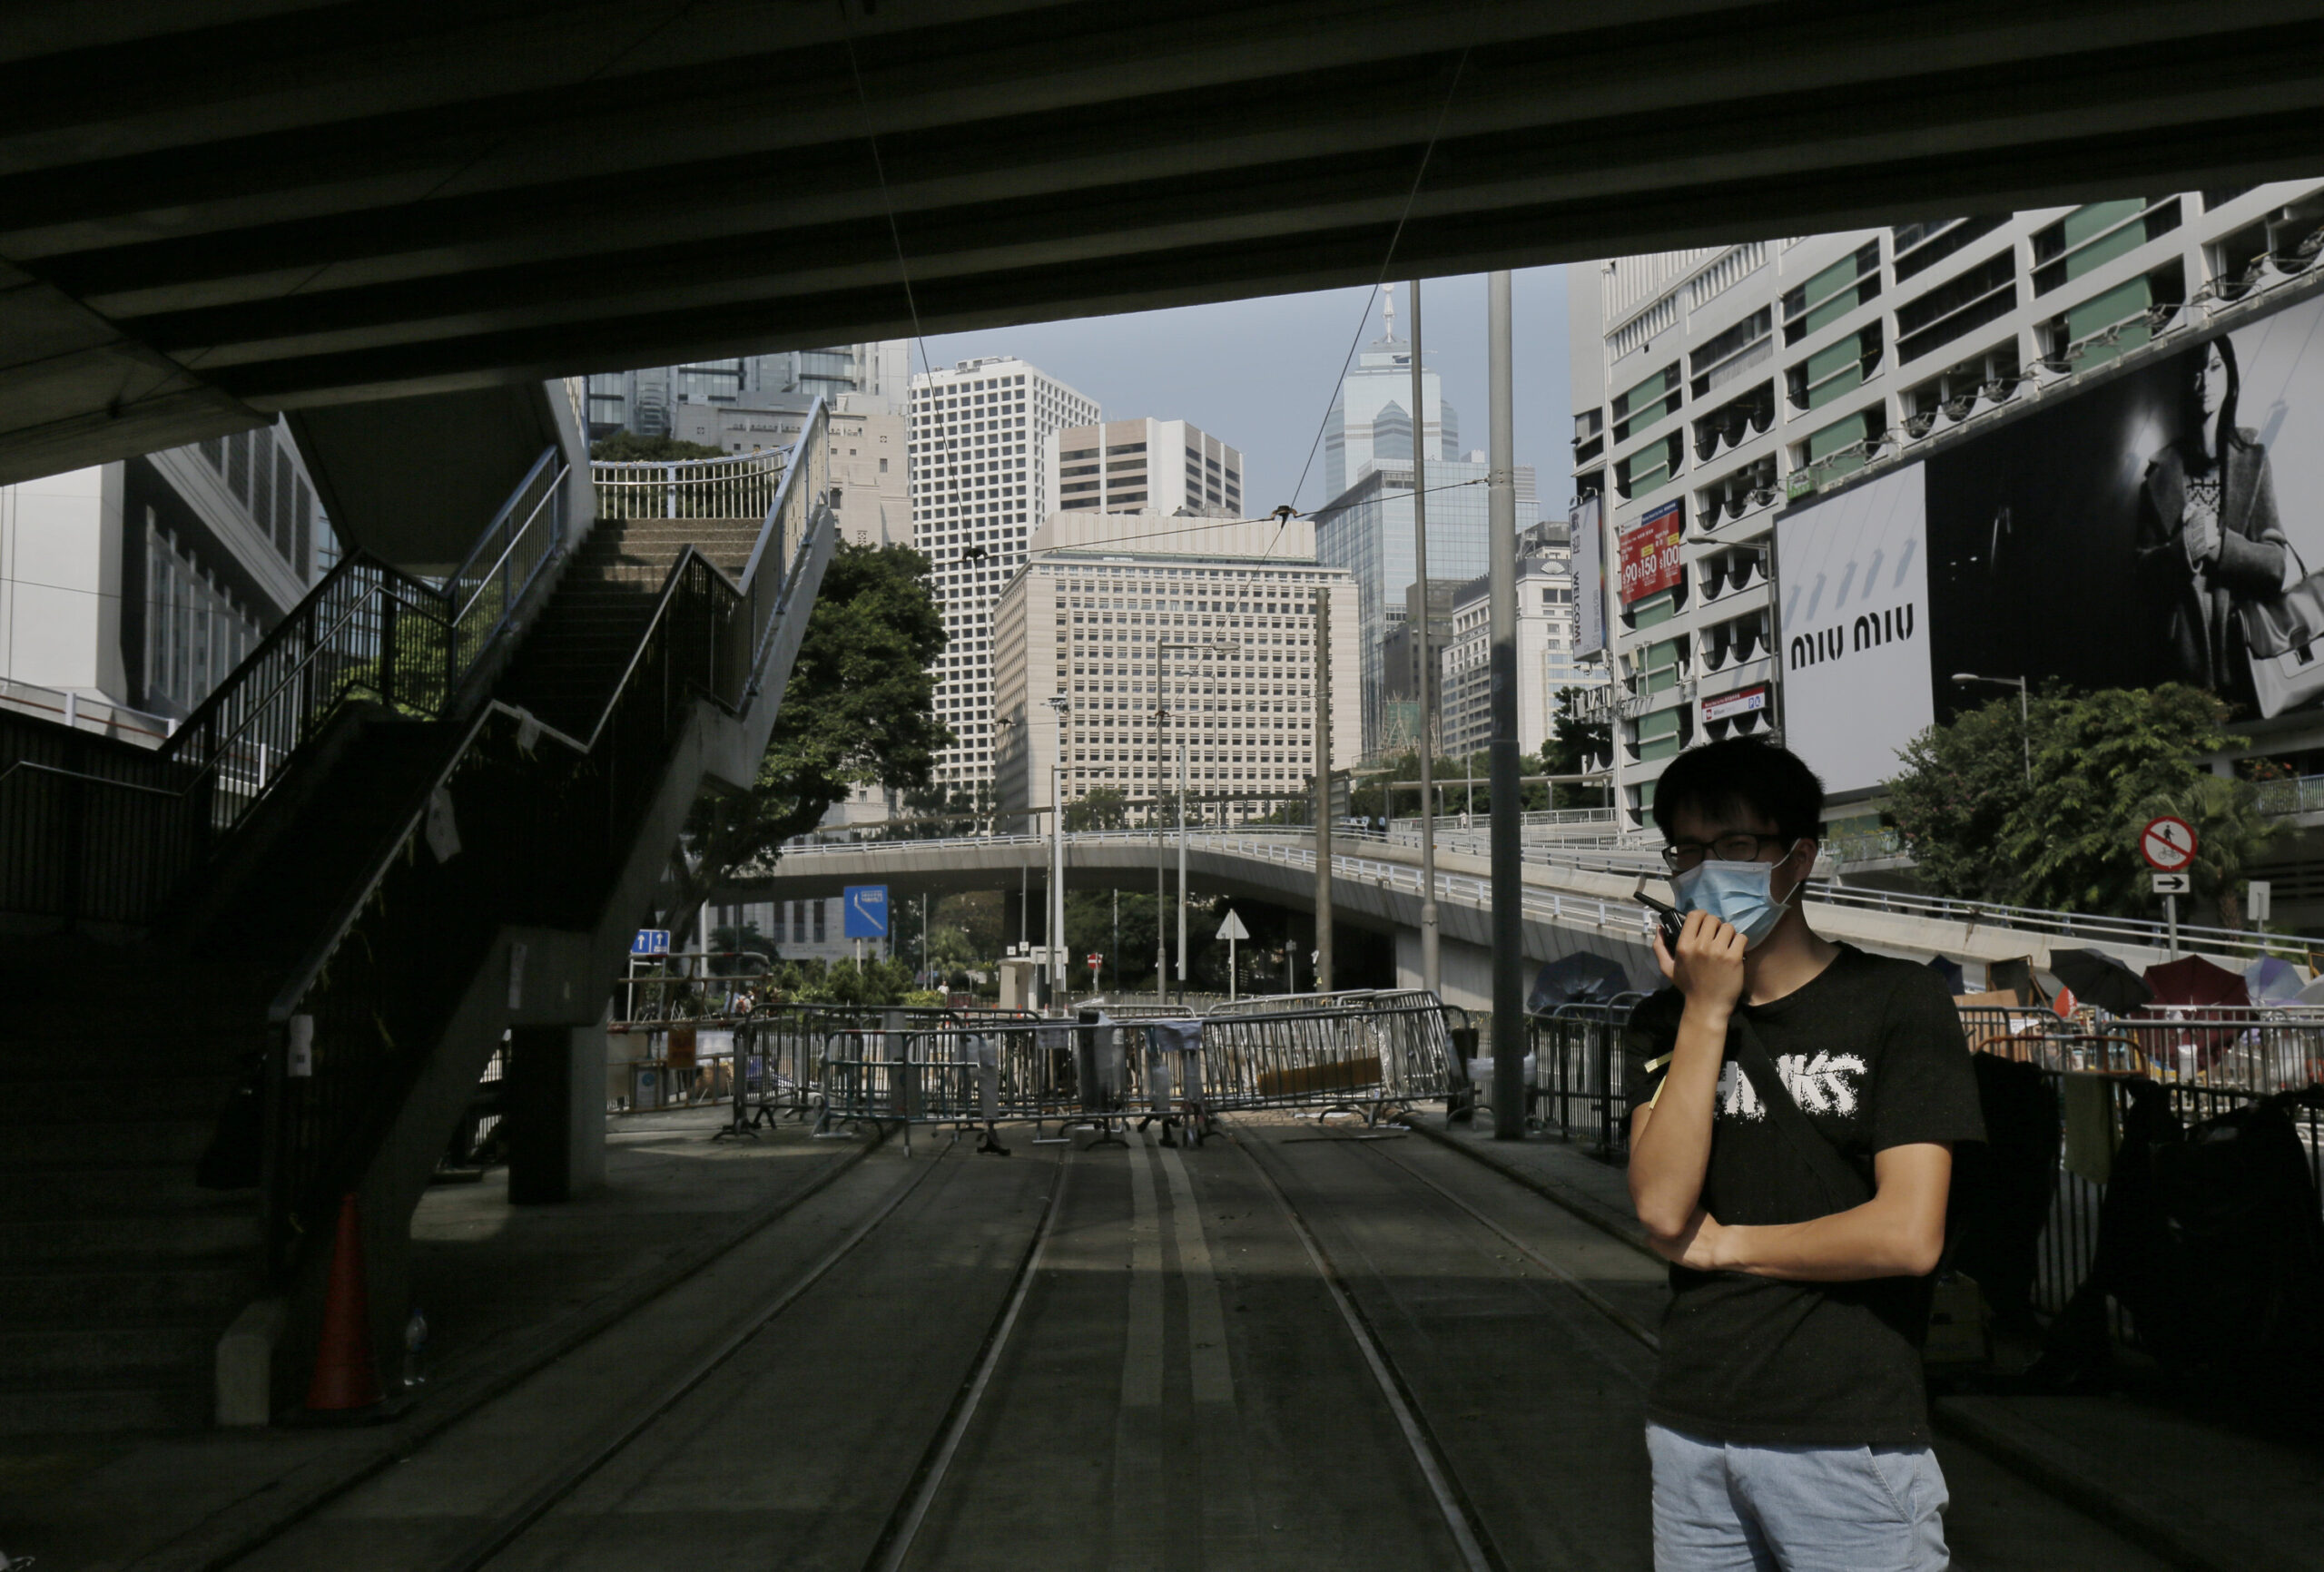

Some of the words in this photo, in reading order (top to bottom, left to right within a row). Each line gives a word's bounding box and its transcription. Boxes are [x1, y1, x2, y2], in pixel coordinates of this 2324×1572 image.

[1622, 562, 1638, 585] $90
[1638, 554, 1658, 578] $150
[1659, 545, 1679, 569] $100
[1572, 571, 1581, 647] WELCOME
